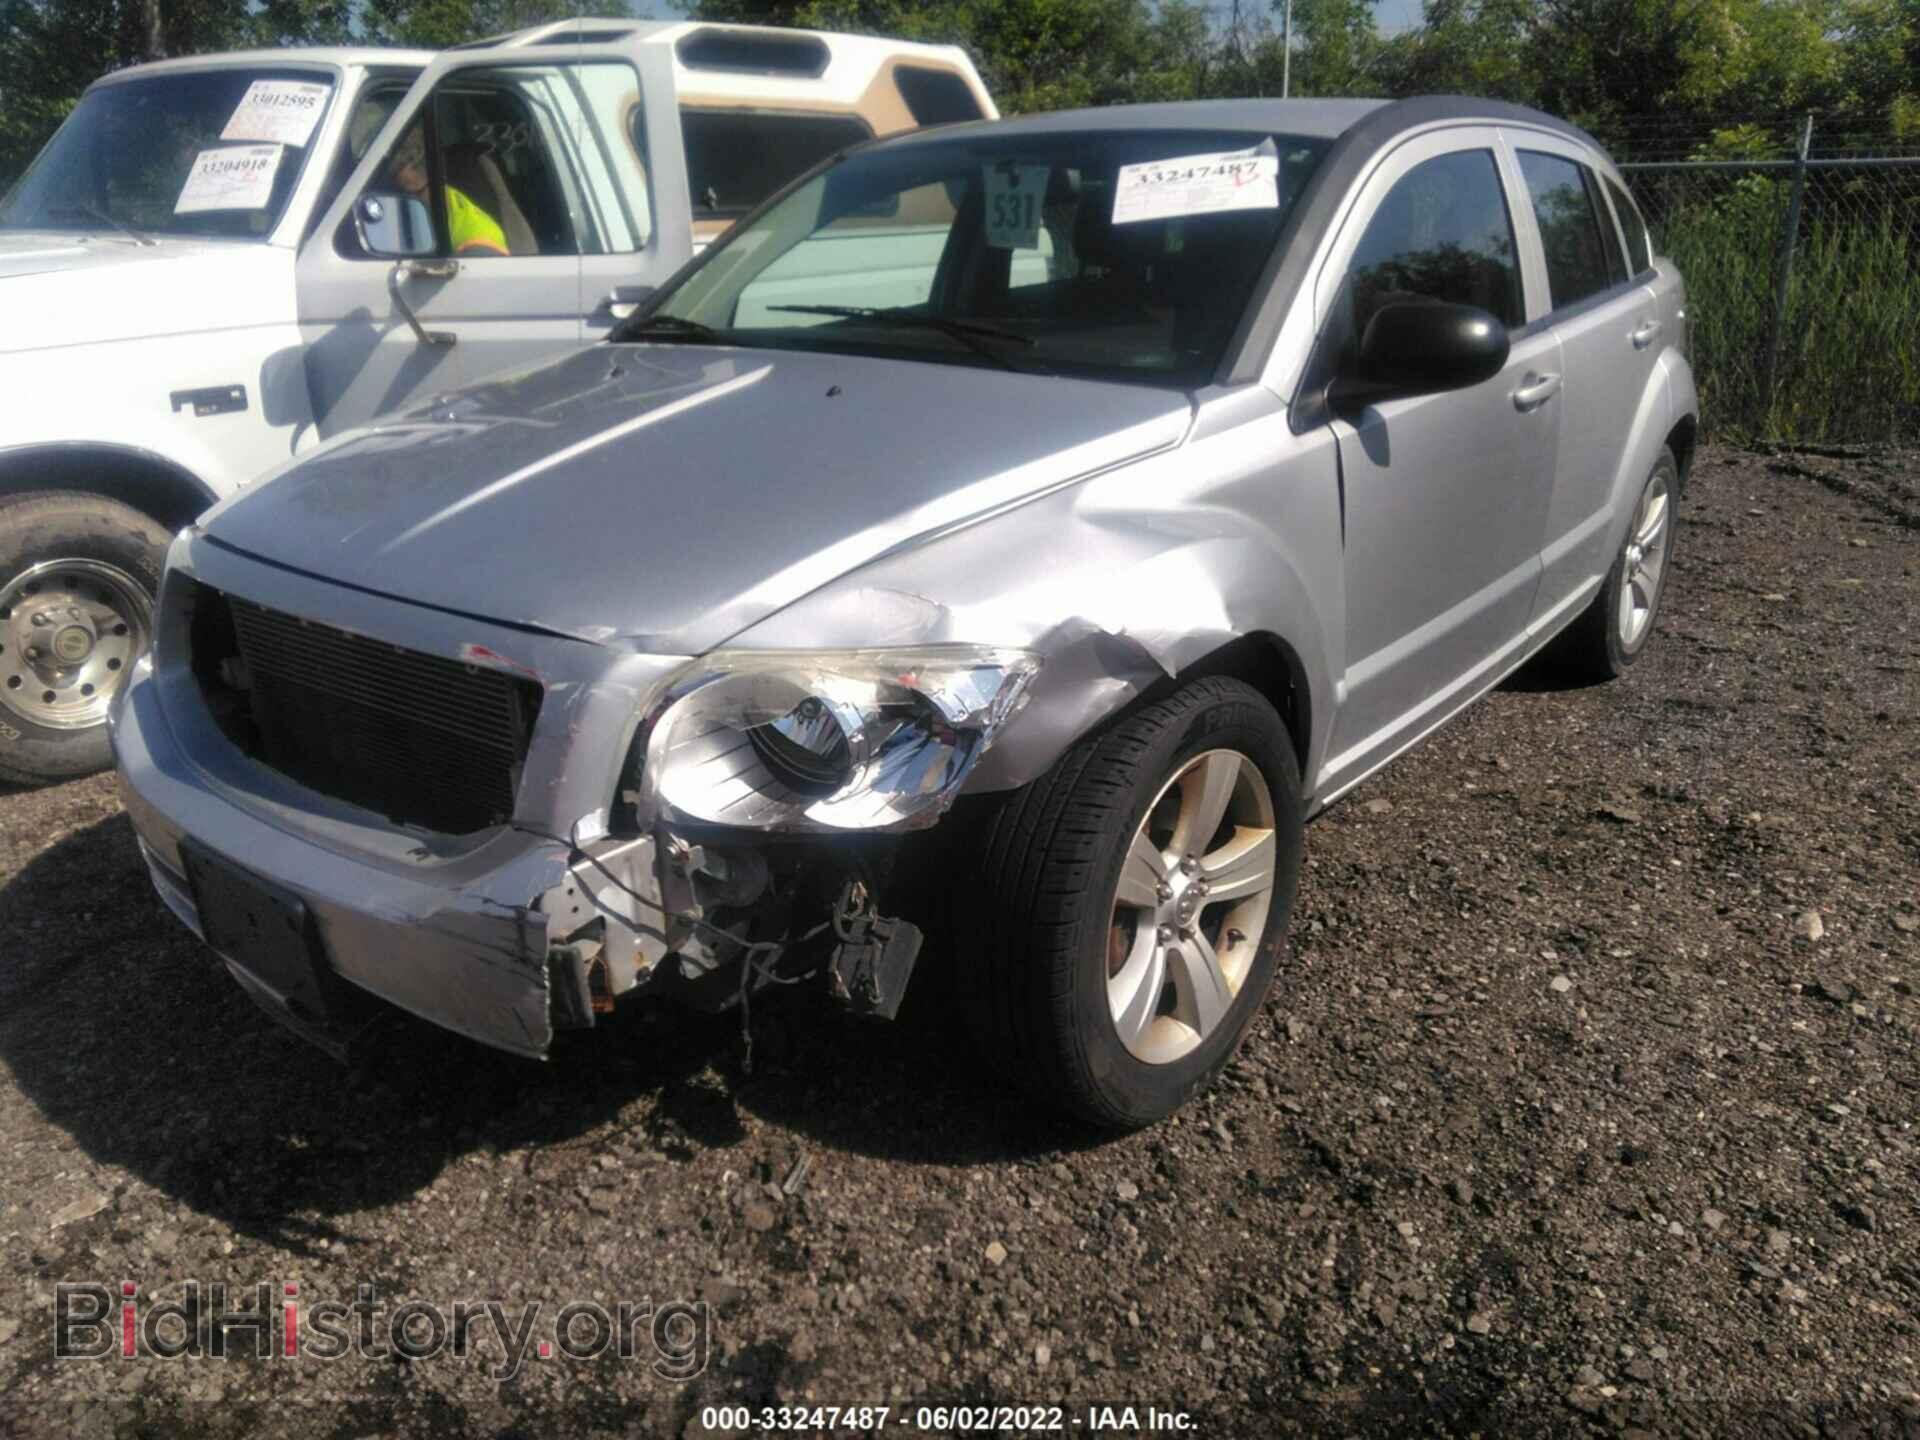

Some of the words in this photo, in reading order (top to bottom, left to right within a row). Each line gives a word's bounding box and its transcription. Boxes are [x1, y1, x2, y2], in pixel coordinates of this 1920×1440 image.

[199, 157, 268, 177] 33204918
[1134, 161, 1258, 187] 33247487
[992, 192, 1035, 229] 531
